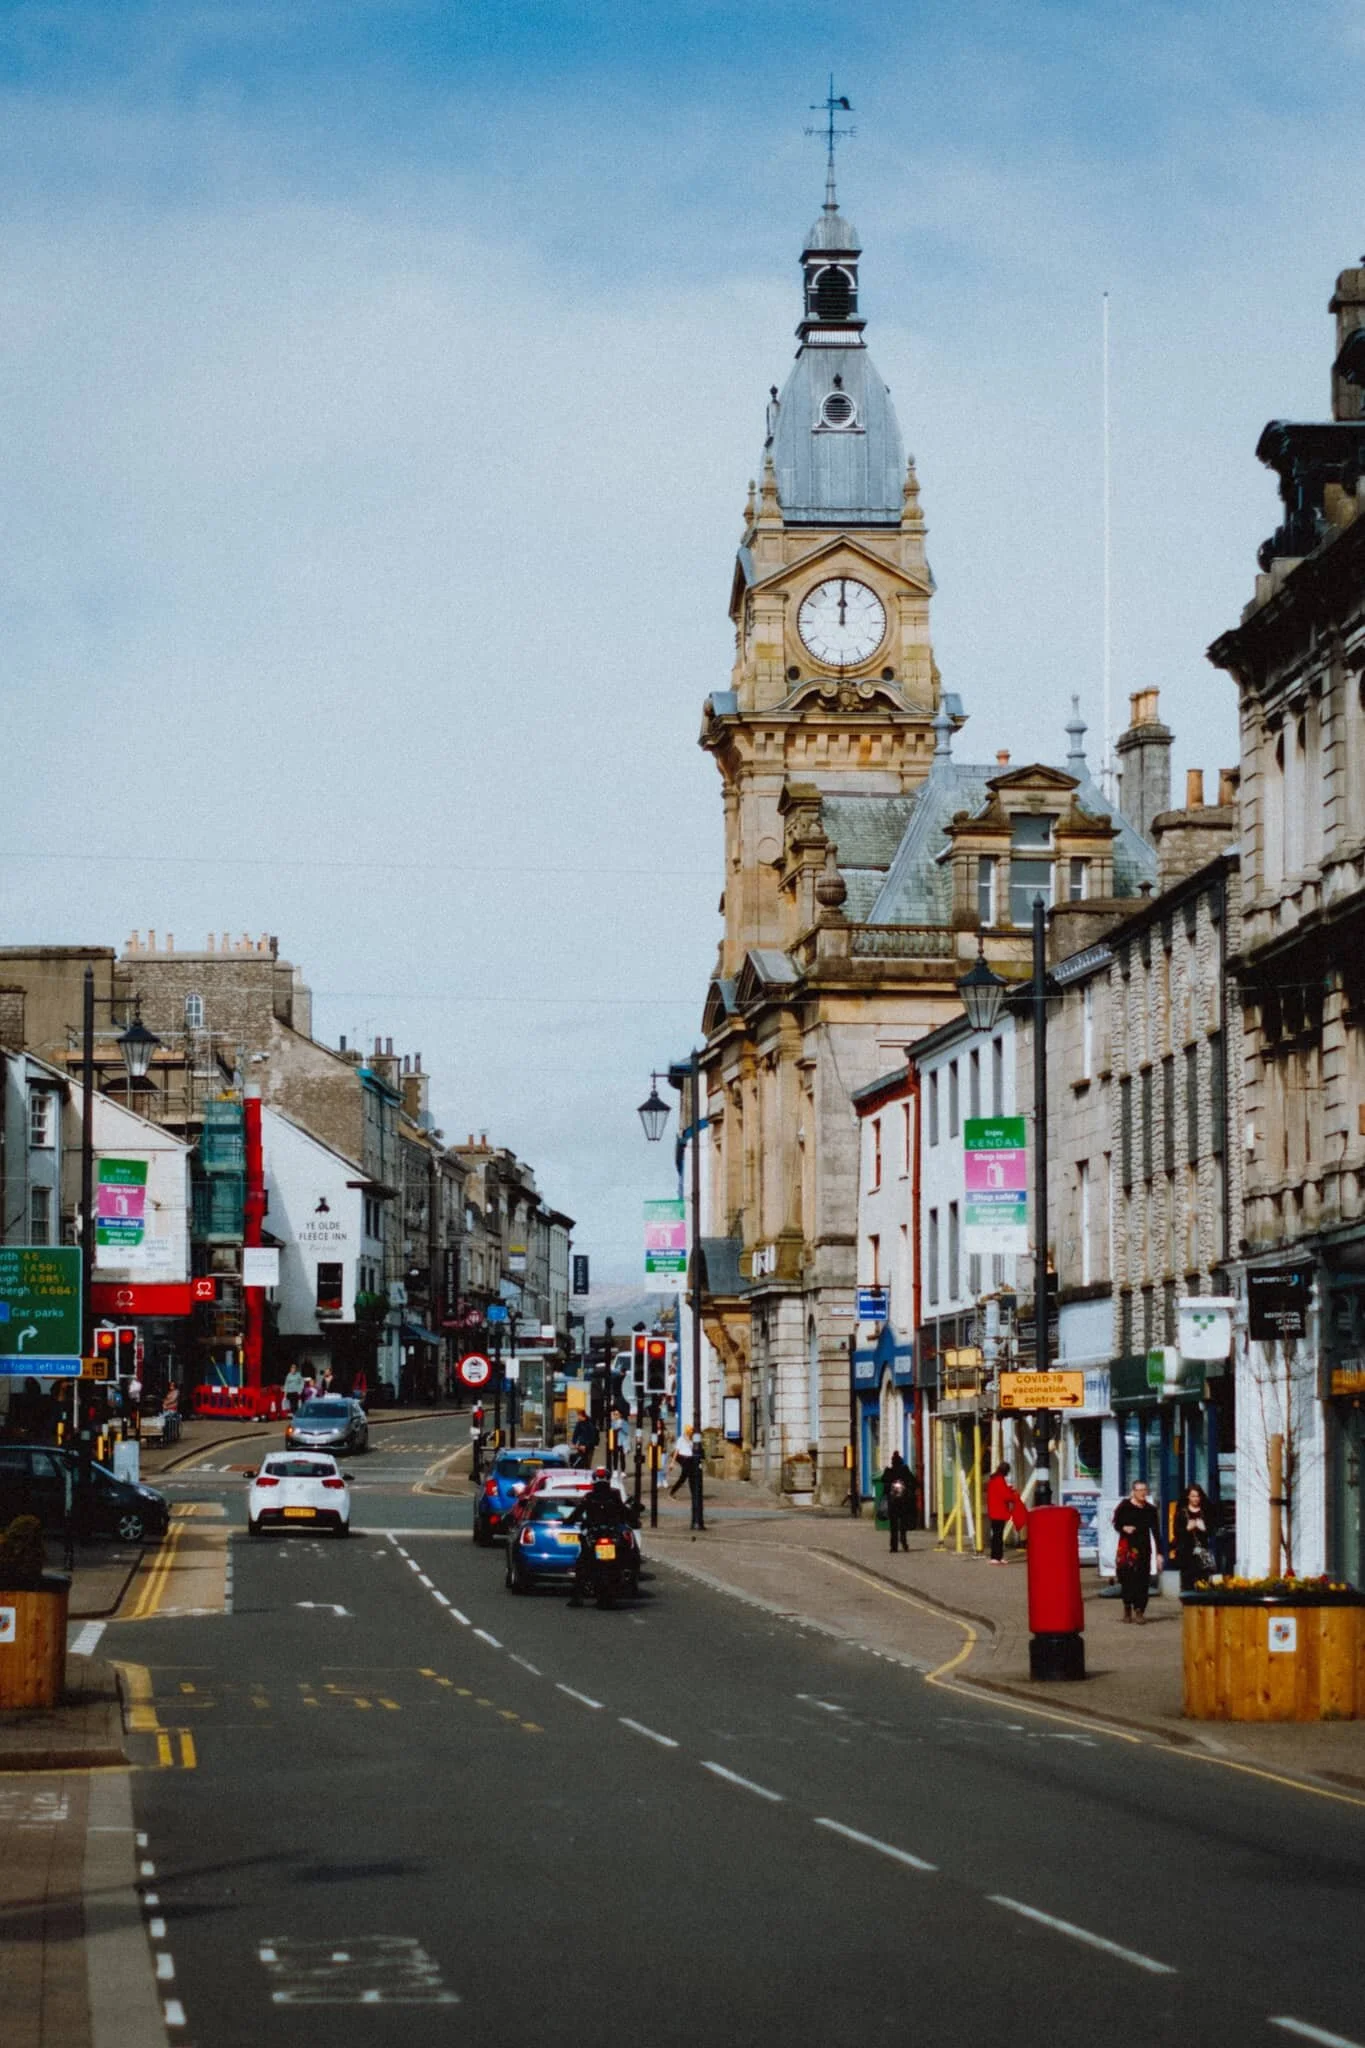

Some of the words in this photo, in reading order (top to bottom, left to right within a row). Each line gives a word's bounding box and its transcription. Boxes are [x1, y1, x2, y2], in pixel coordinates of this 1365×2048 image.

[968, 1138, 1020, 1148] KENDAL
[974, 1153, 995, 1162] Shop
[996, 1152, 1016, 1160] local
[973, 1193, 994, 1202] Shop
[306, 1221, 315, 1230] YE
[318, 1221, 340, 1230] OLDE
[299, 1232, 329, 1241] FLEECE
[332, 1232, 348, 1240] INN
[11, 1307, 30, 1317] Car
[35, 1308, 65, 1319] parks
[36, 1361, 53, 1371] left
[55, 1362, 77, 1371] lane
[1016, 1374, 1064, 1384] COVID-19
[1013, 1385, 1068, 1393] vaccination
[1024, 1395, 1055, 1403] centre
